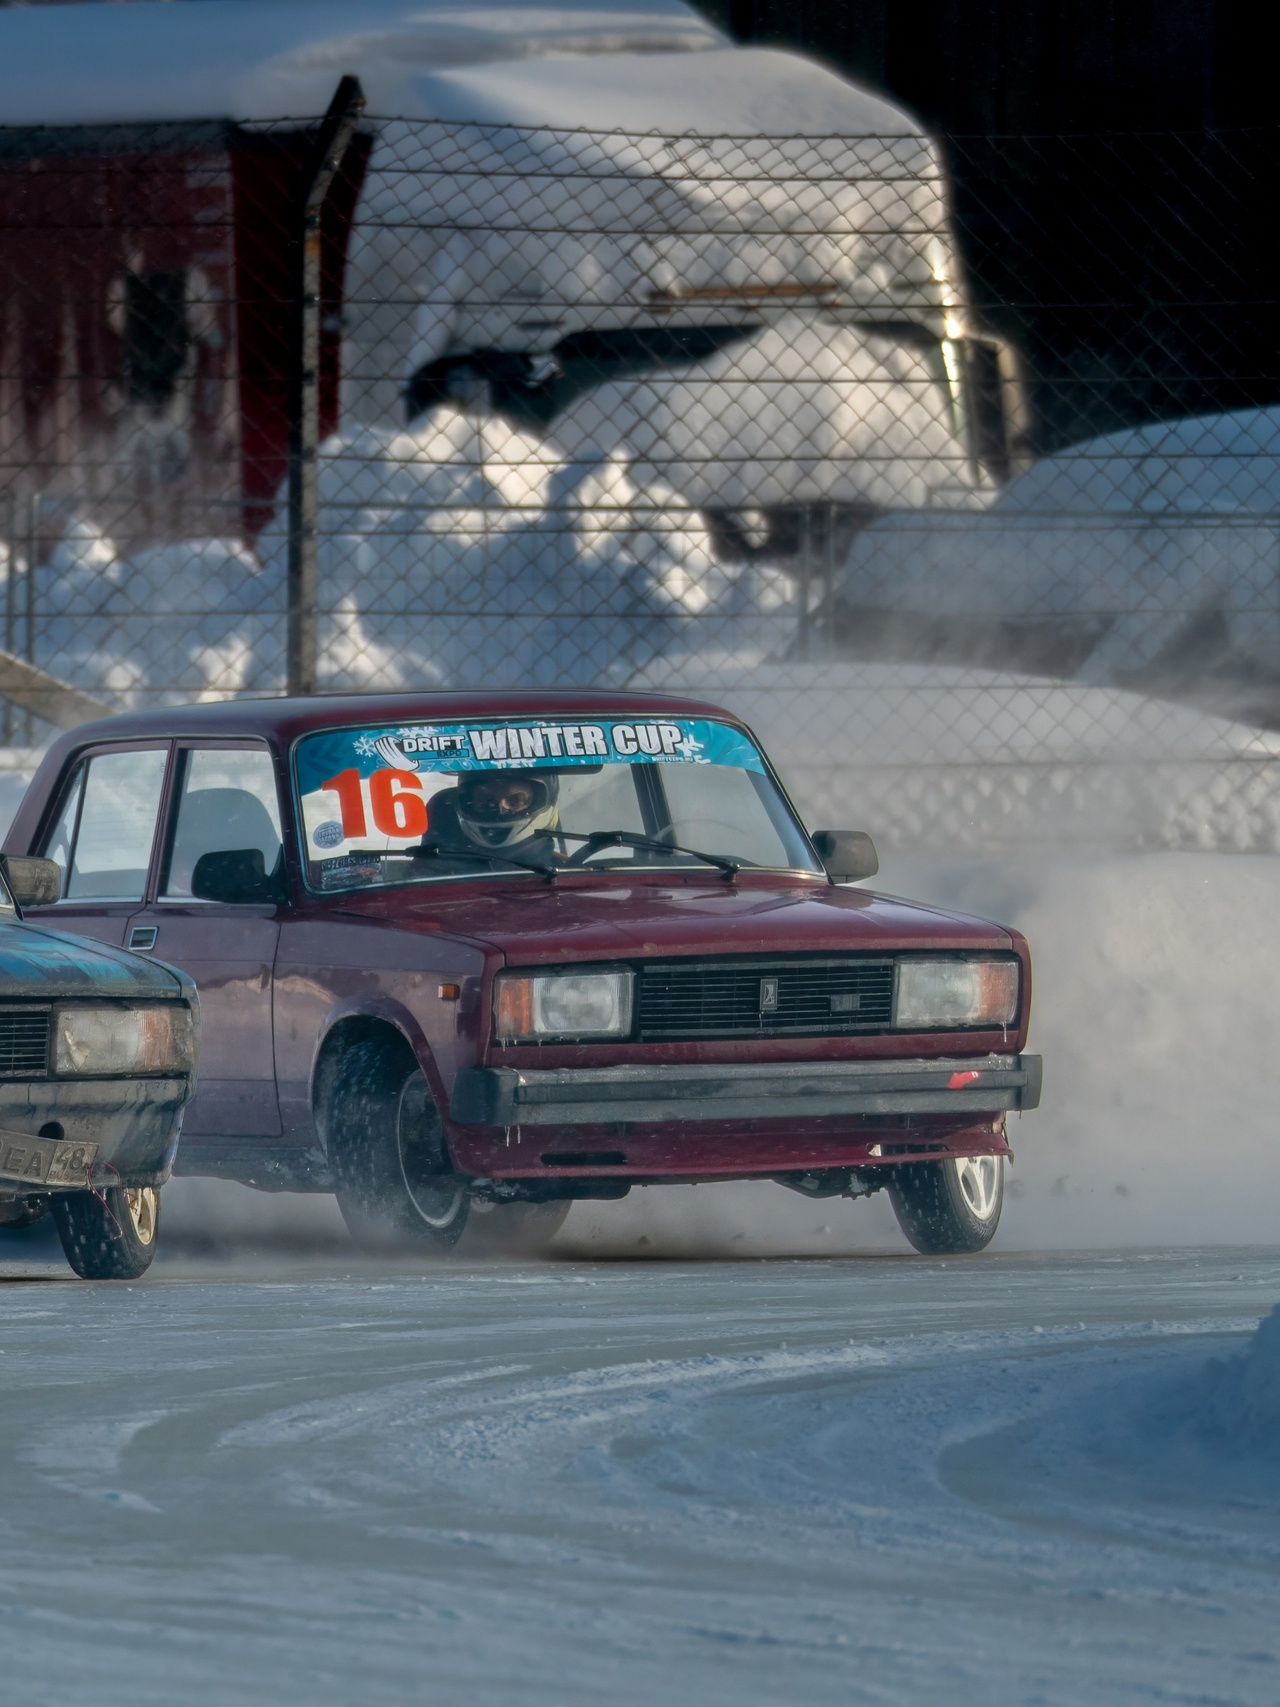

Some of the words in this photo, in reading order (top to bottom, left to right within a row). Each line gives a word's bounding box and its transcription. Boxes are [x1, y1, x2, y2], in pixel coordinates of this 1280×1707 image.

[402, 736, 464, 752] DRIFT
[468, 726, 609, 760] WINTER
[611, 724, 682, 755] CUP
[436, 750, 462, 758] EXPO
[321, 768, 428, 839] 16
